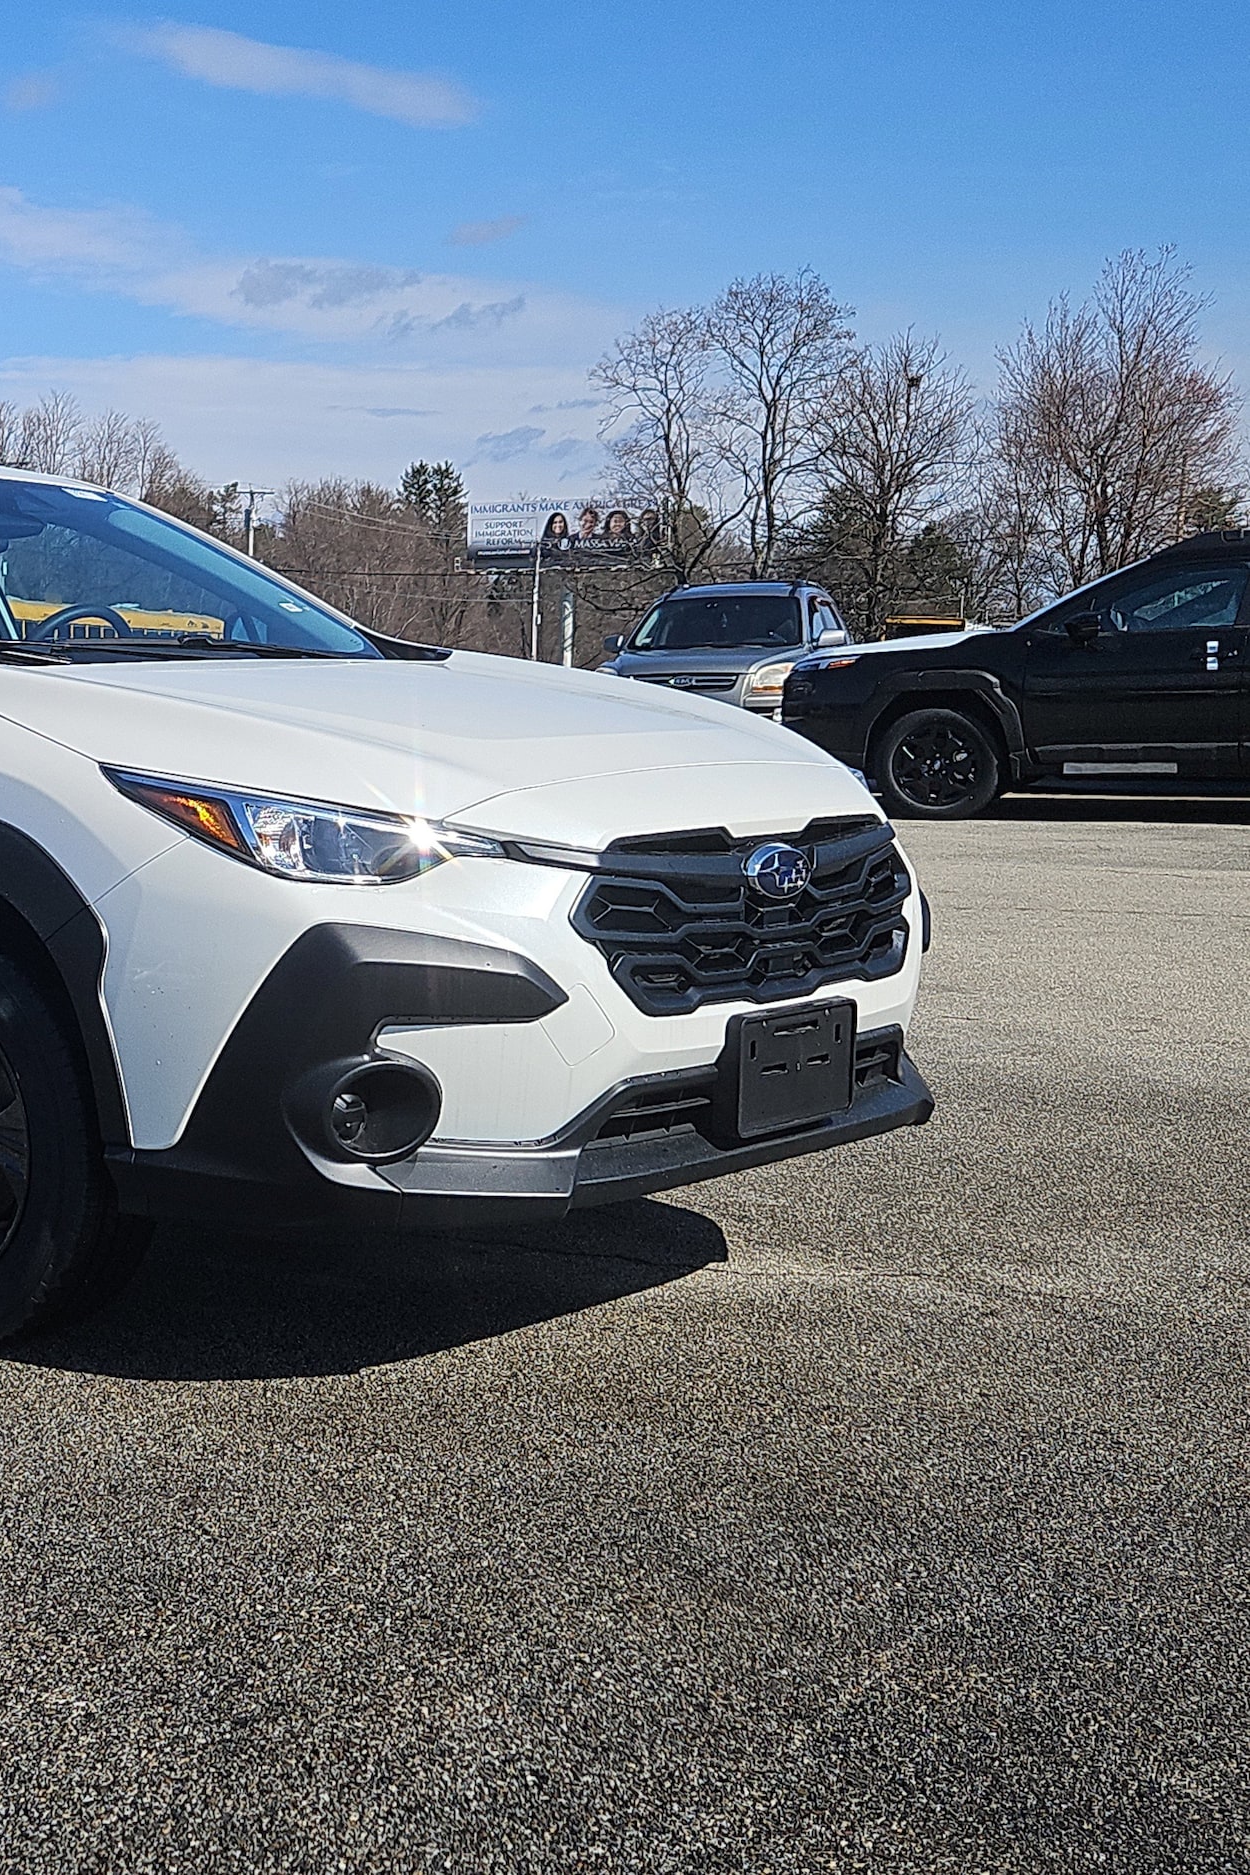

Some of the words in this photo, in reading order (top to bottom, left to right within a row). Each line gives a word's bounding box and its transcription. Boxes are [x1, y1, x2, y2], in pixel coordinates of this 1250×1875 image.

[471, 503, 537, 514] IMMIGRANTS
[539, 501, 569, 512] MAKE
[484, 520, 523, 530] SUPPORT
[475, 528, 533, 538] IMMIGRATION
[485, 538, 523, 546] REFORM
